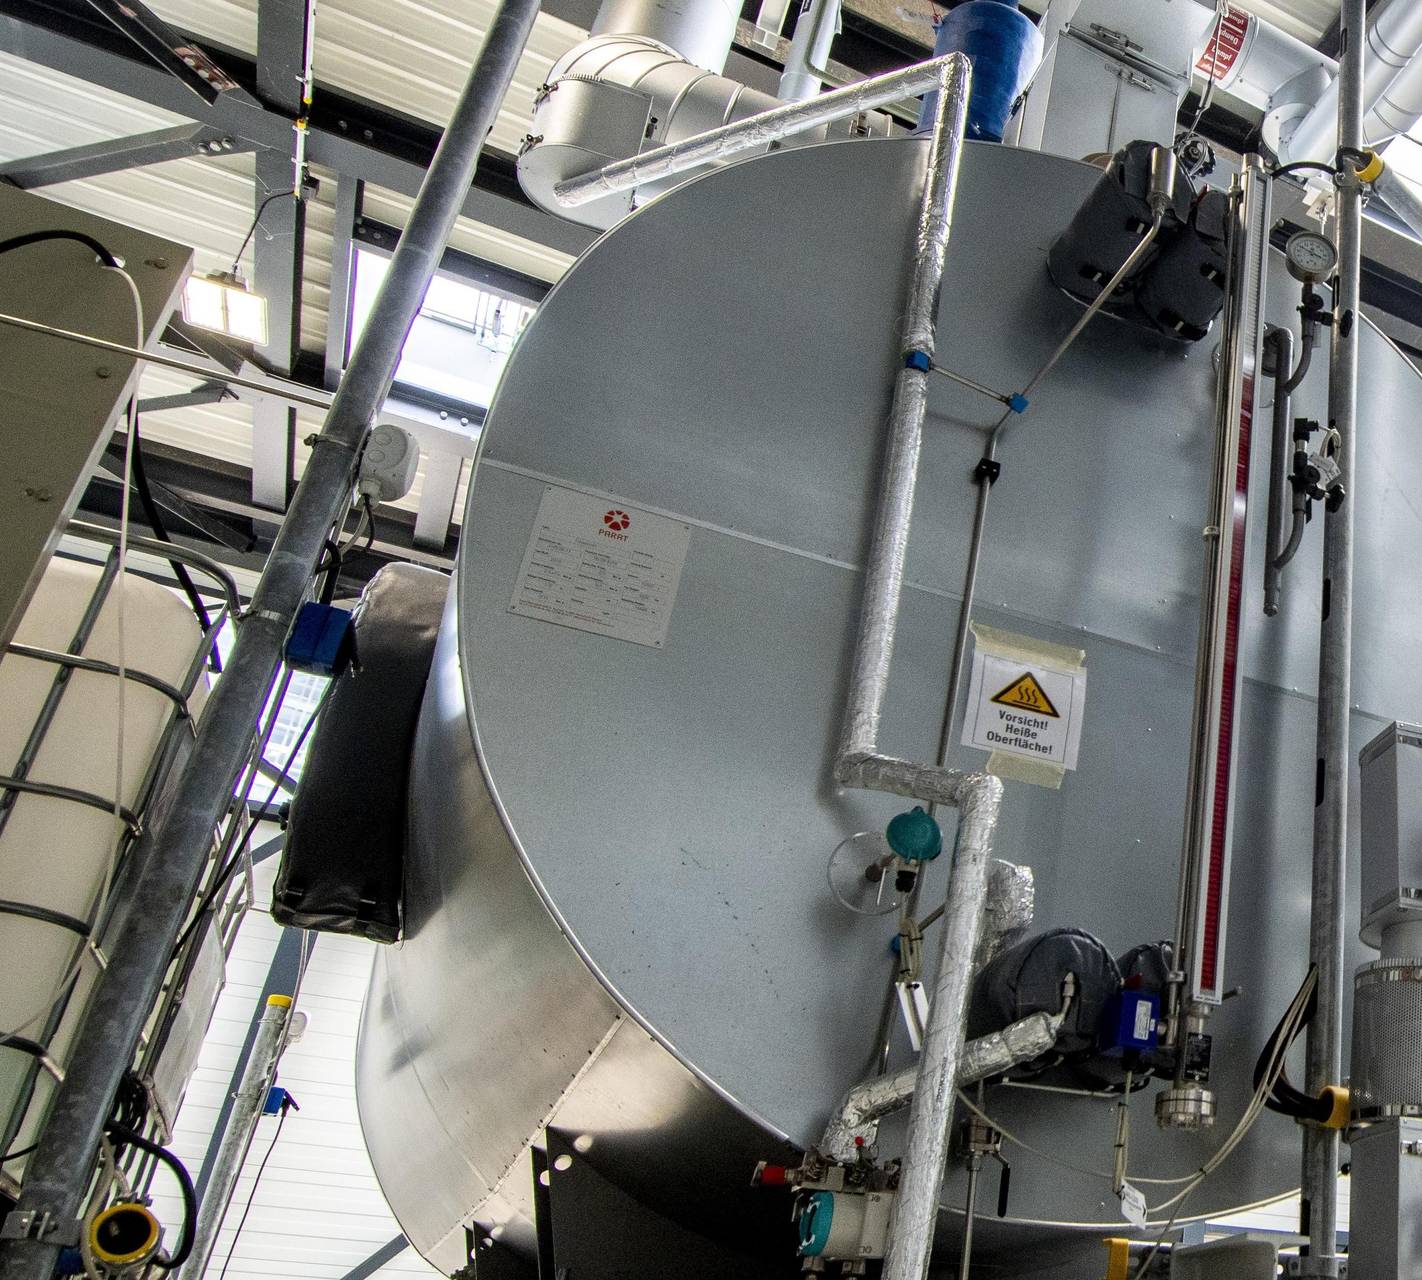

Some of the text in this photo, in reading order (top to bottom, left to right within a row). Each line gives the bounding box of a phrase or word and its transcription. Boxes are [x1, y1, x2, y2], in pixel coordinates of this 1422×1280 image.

[1220, 30, 1239, 45] Damp
[598, 528, 628, 541] PARAT
[999, 710, 1049, 730] Vorsicht!
[1005, 723, 1038, 740] Heiße
[986, 730, 1053, 755] Oberfläche!
